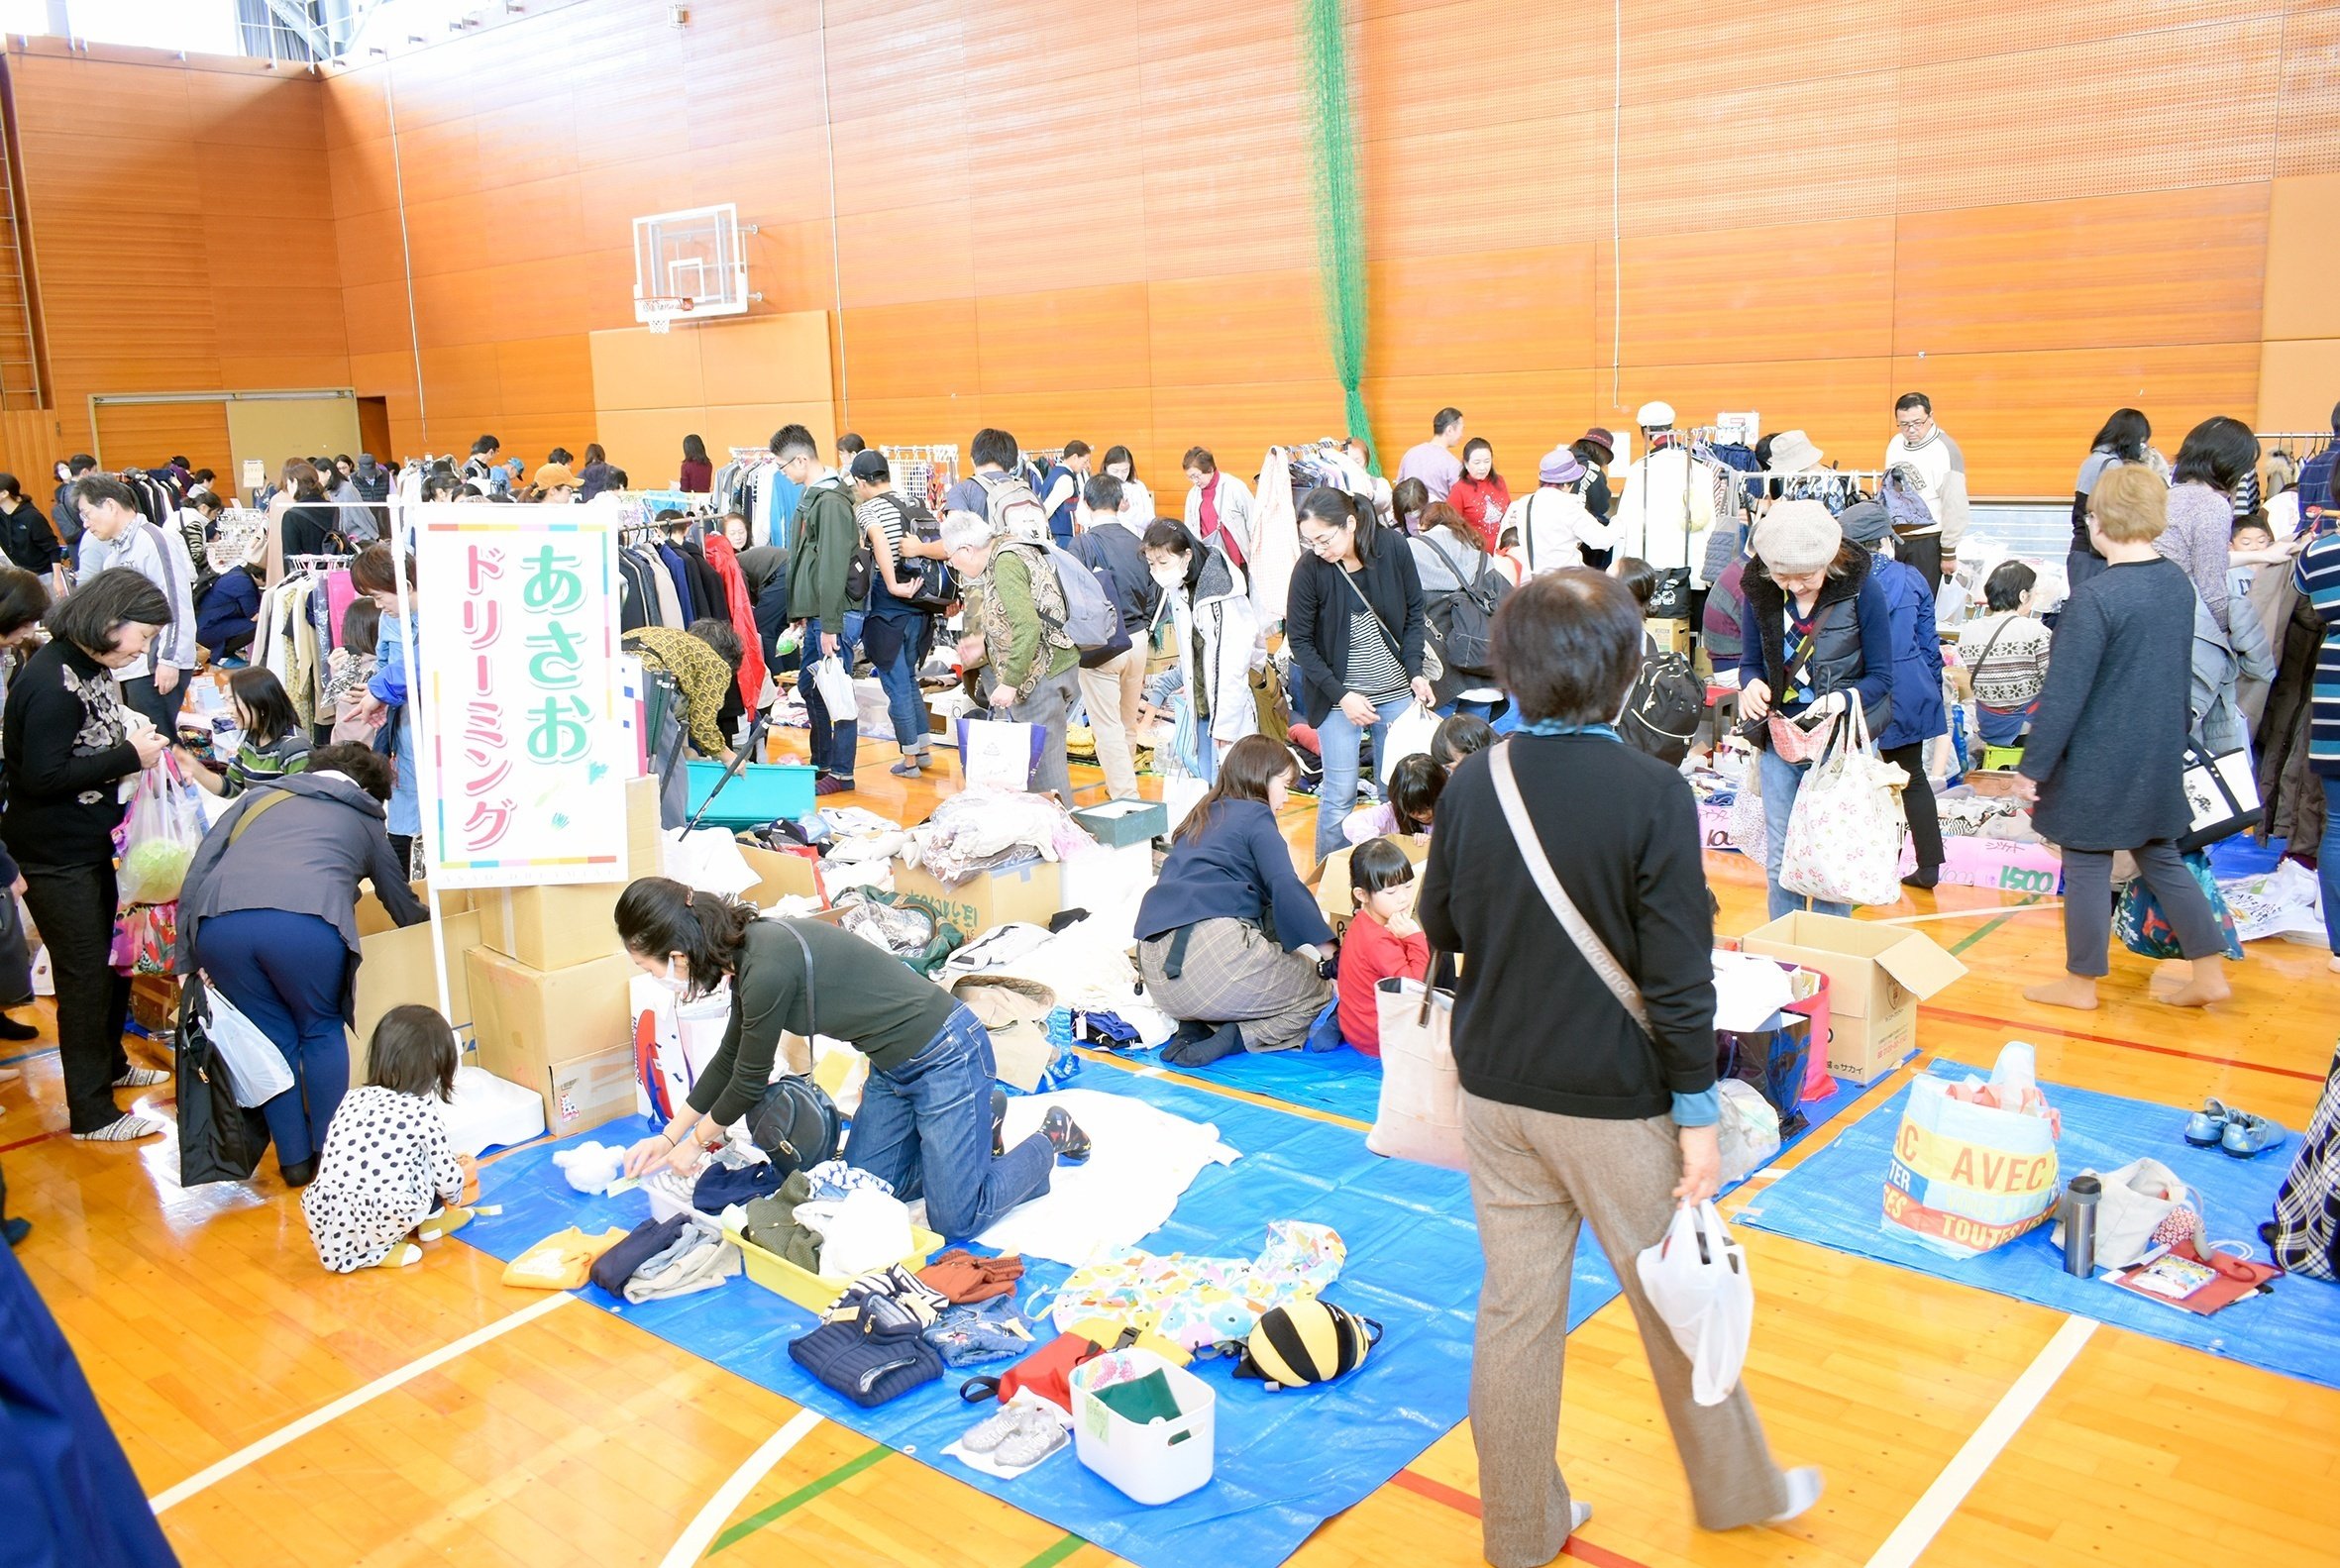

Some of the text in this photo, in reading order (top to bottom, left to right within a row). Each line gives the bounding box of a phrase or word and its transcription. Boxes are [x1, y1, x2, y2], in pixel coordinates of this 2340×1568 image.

[520, 544, 593, 763] あさお
[462, 544, 515, 850] ドリーミング
[1999, 865, 2055, 892] 1500
[1576, 929, 1636, 997] JOURDAN
[1950, 1147, 2048, 1193] AVEC
[1941, 1213, 2021, 1250] TOUTES
